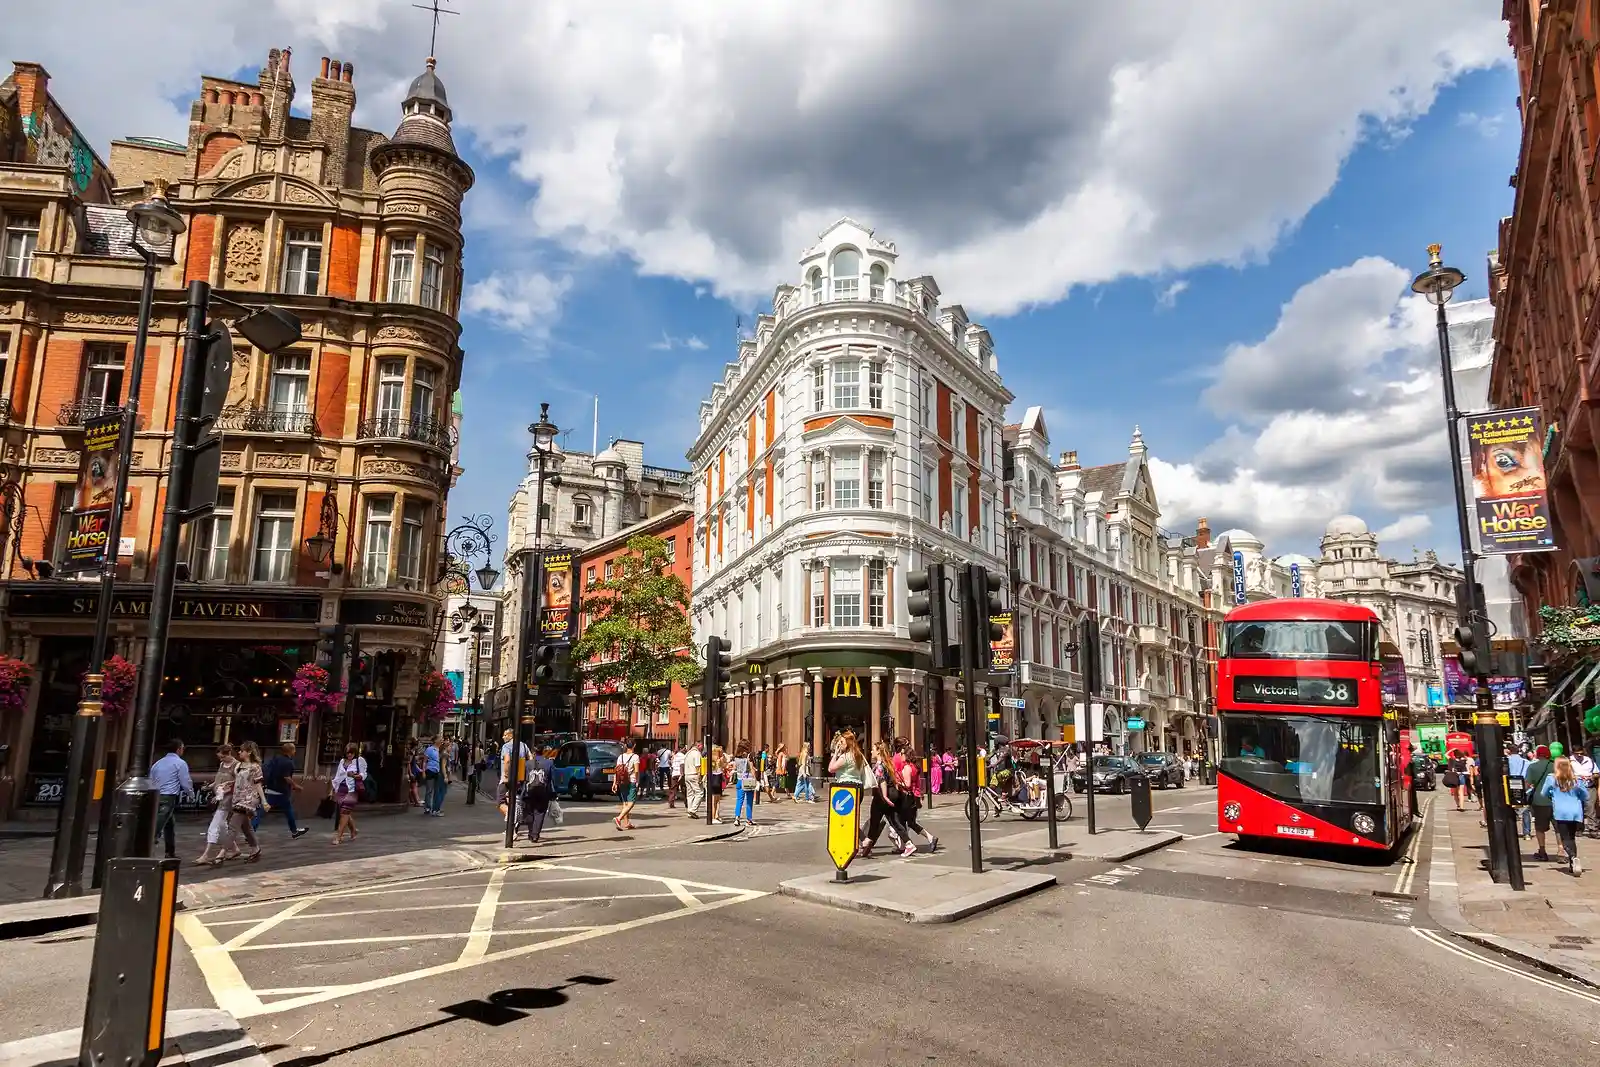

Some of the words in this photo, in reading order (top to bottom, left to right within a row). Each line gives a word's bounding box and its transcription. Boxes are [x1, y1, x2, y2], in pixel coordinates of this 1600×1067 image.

[1492, 502, 1540, 519] War
[78, 514, 106, 533] War
[1480, 515, 1547, 534] Horse
[67, 530, 107, 549] Horse
[1234, 559, 1245, 600] LYRIC
[179, 600, 262, 617] TAVERN
[547, 610, 567, 622] War
[388, 615, 418, 625] JAMES
[541, 620, 569, 632] Horse
[1253, 683, 1298, 696] Victoria
[1323, 683, 1349, 701] 38
[133, 884, 143, 903] 4
